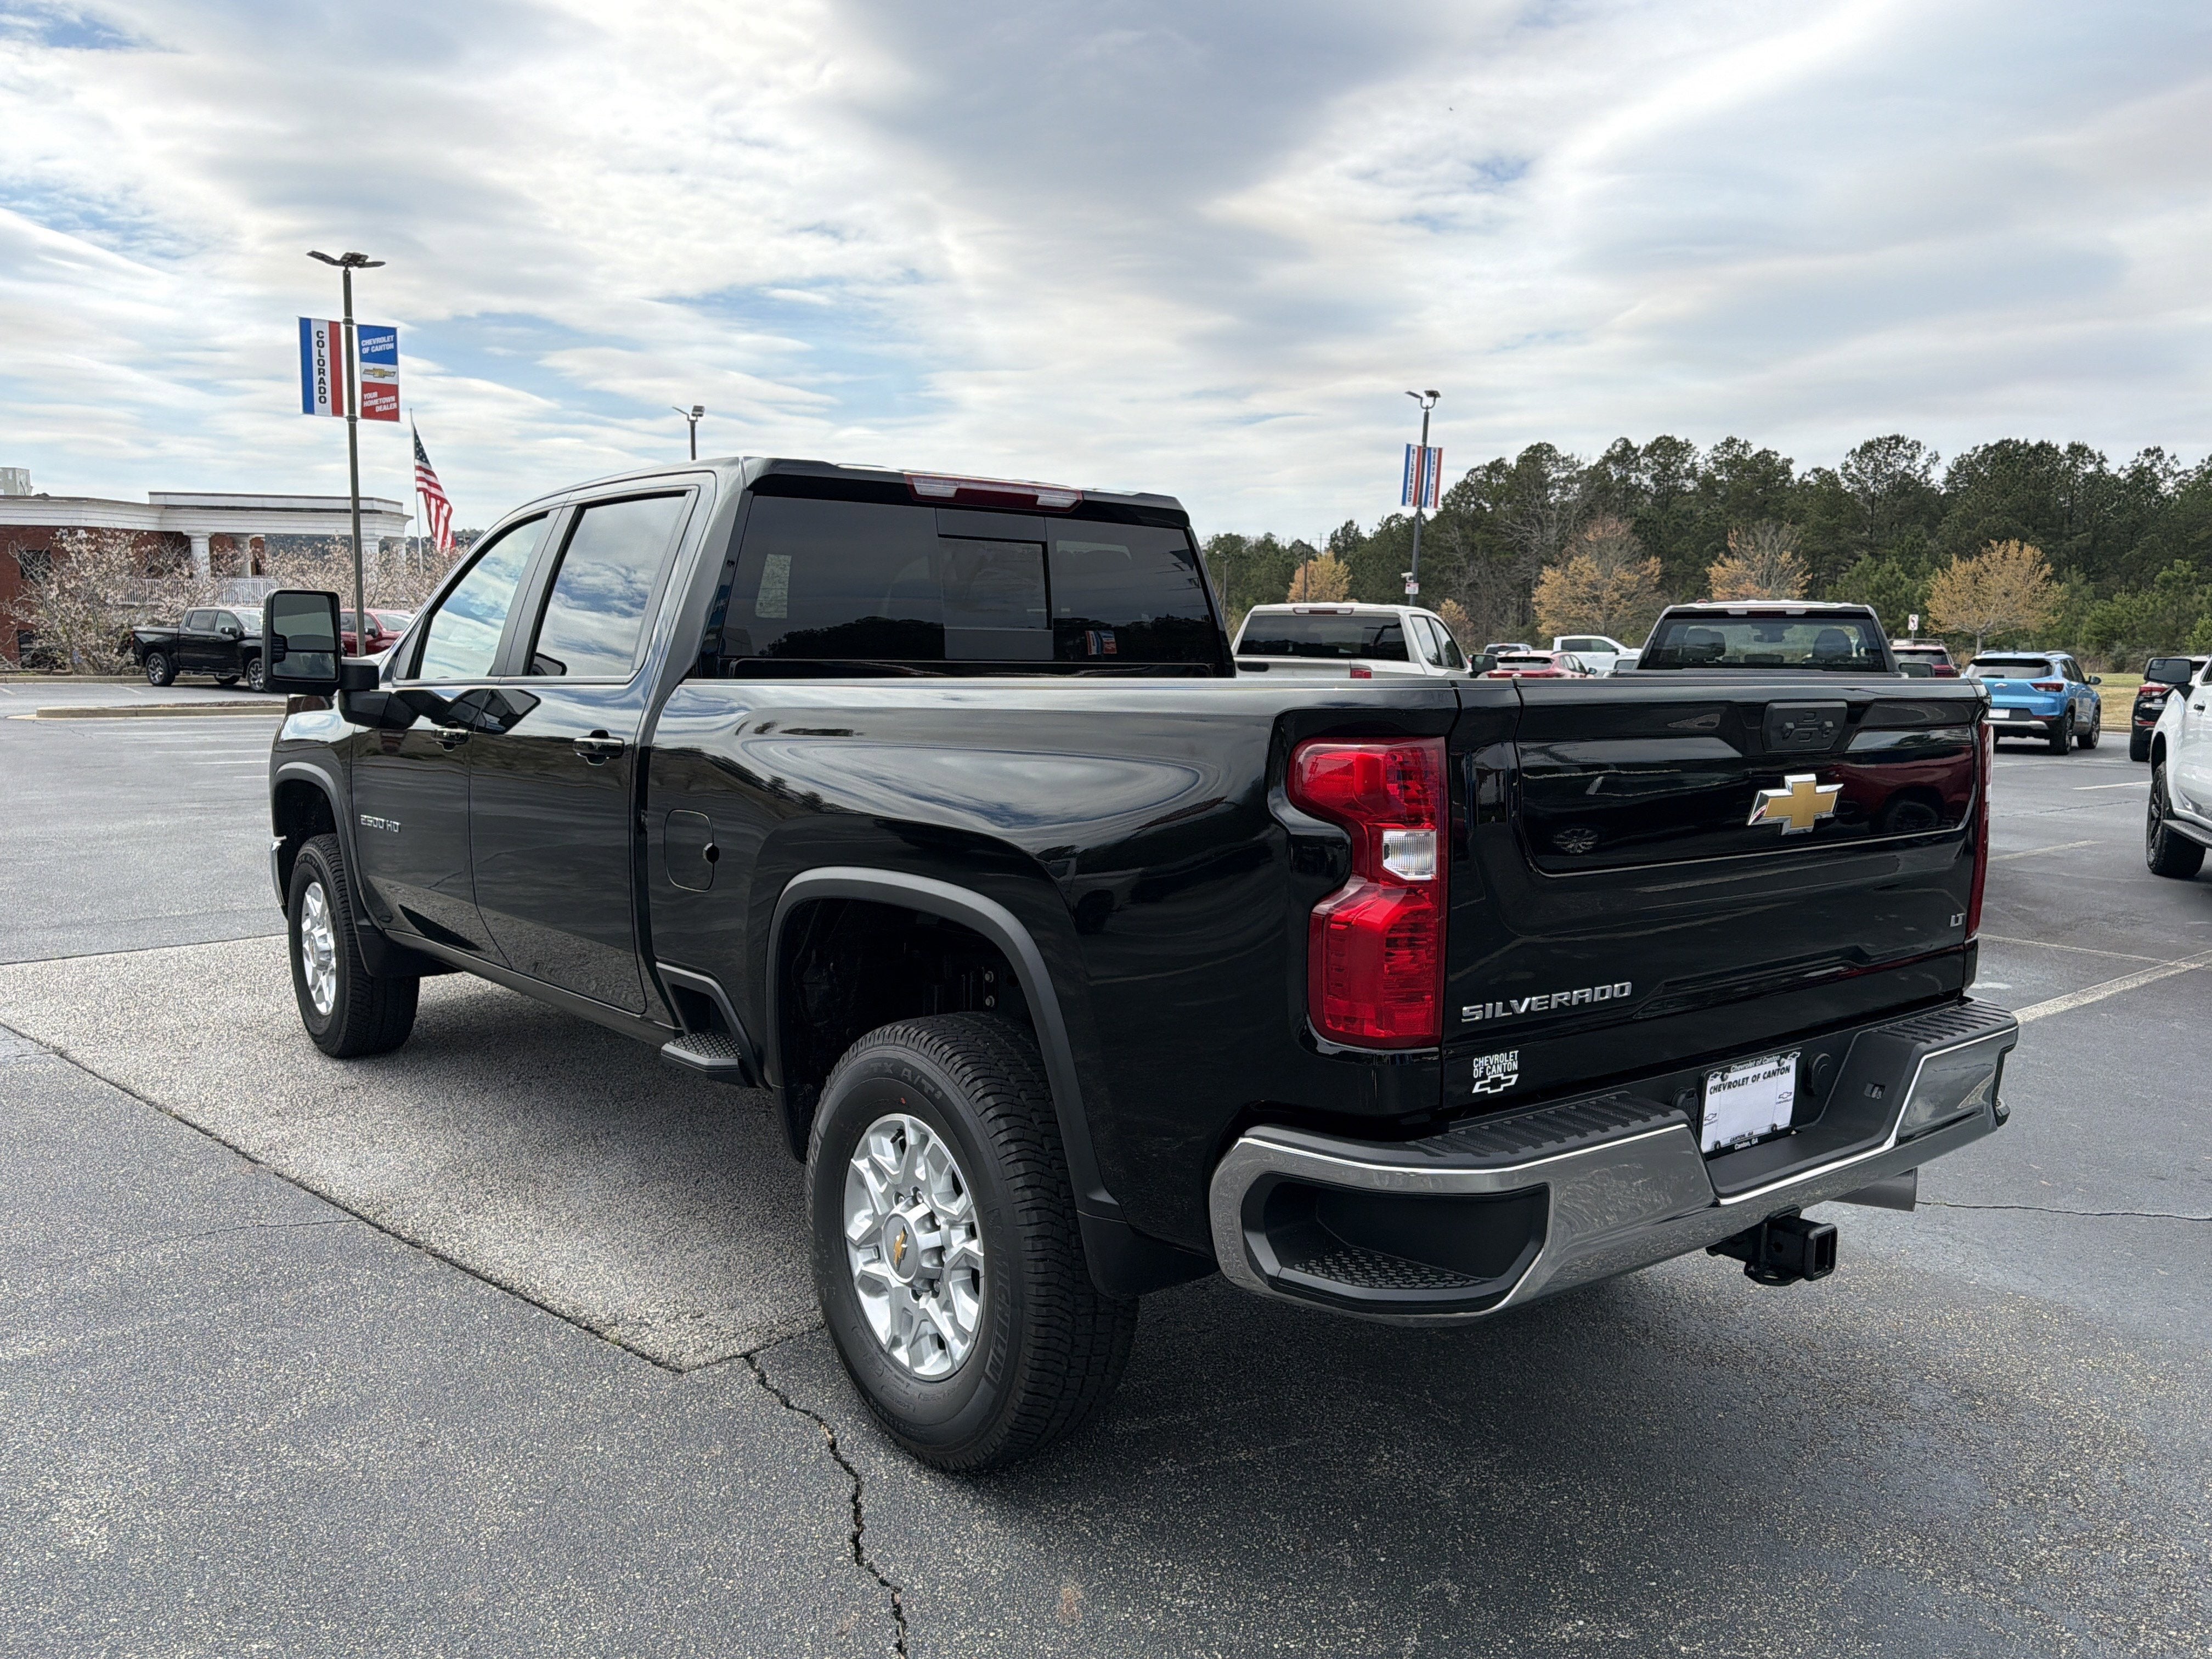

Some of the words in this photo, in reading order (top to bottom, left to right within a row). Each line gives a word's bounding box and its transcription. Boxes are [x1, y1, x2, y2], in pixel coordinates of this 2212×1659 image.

[361, 335, 394, 347] CHEVROLET
[371, 343, 394, 353] CANTON
[316, 330, 327, 404] COLORADO
[363, 396, 396, 407] HOMETOWN
[364, 391, 378, 400] YOUR
[375, 403, 397, 413] DEALER
[1408, 449, 1416, 502] SILVERADO
[386, 820, 401, 833] HD
[1950, 913, 1965, 927] LT
[1461, 981, 1632, 1023] SILVERADO
[1473, 1050, 1519, 1068] CHEVROLET
[1730, 1060, 1756, 1073] Chevrolet
[1762, 1055, 1780, 1064] Canton
[1473, 1067, 1484, 1079] OF
[1486, 1060, 1518, 1076] CANTON
[1709, 1076, 1750, 1095] CHEVROLET
[1751, 1073, 1761, 1083] OF
[1762, 1065, 1791, 1080] CANTON
